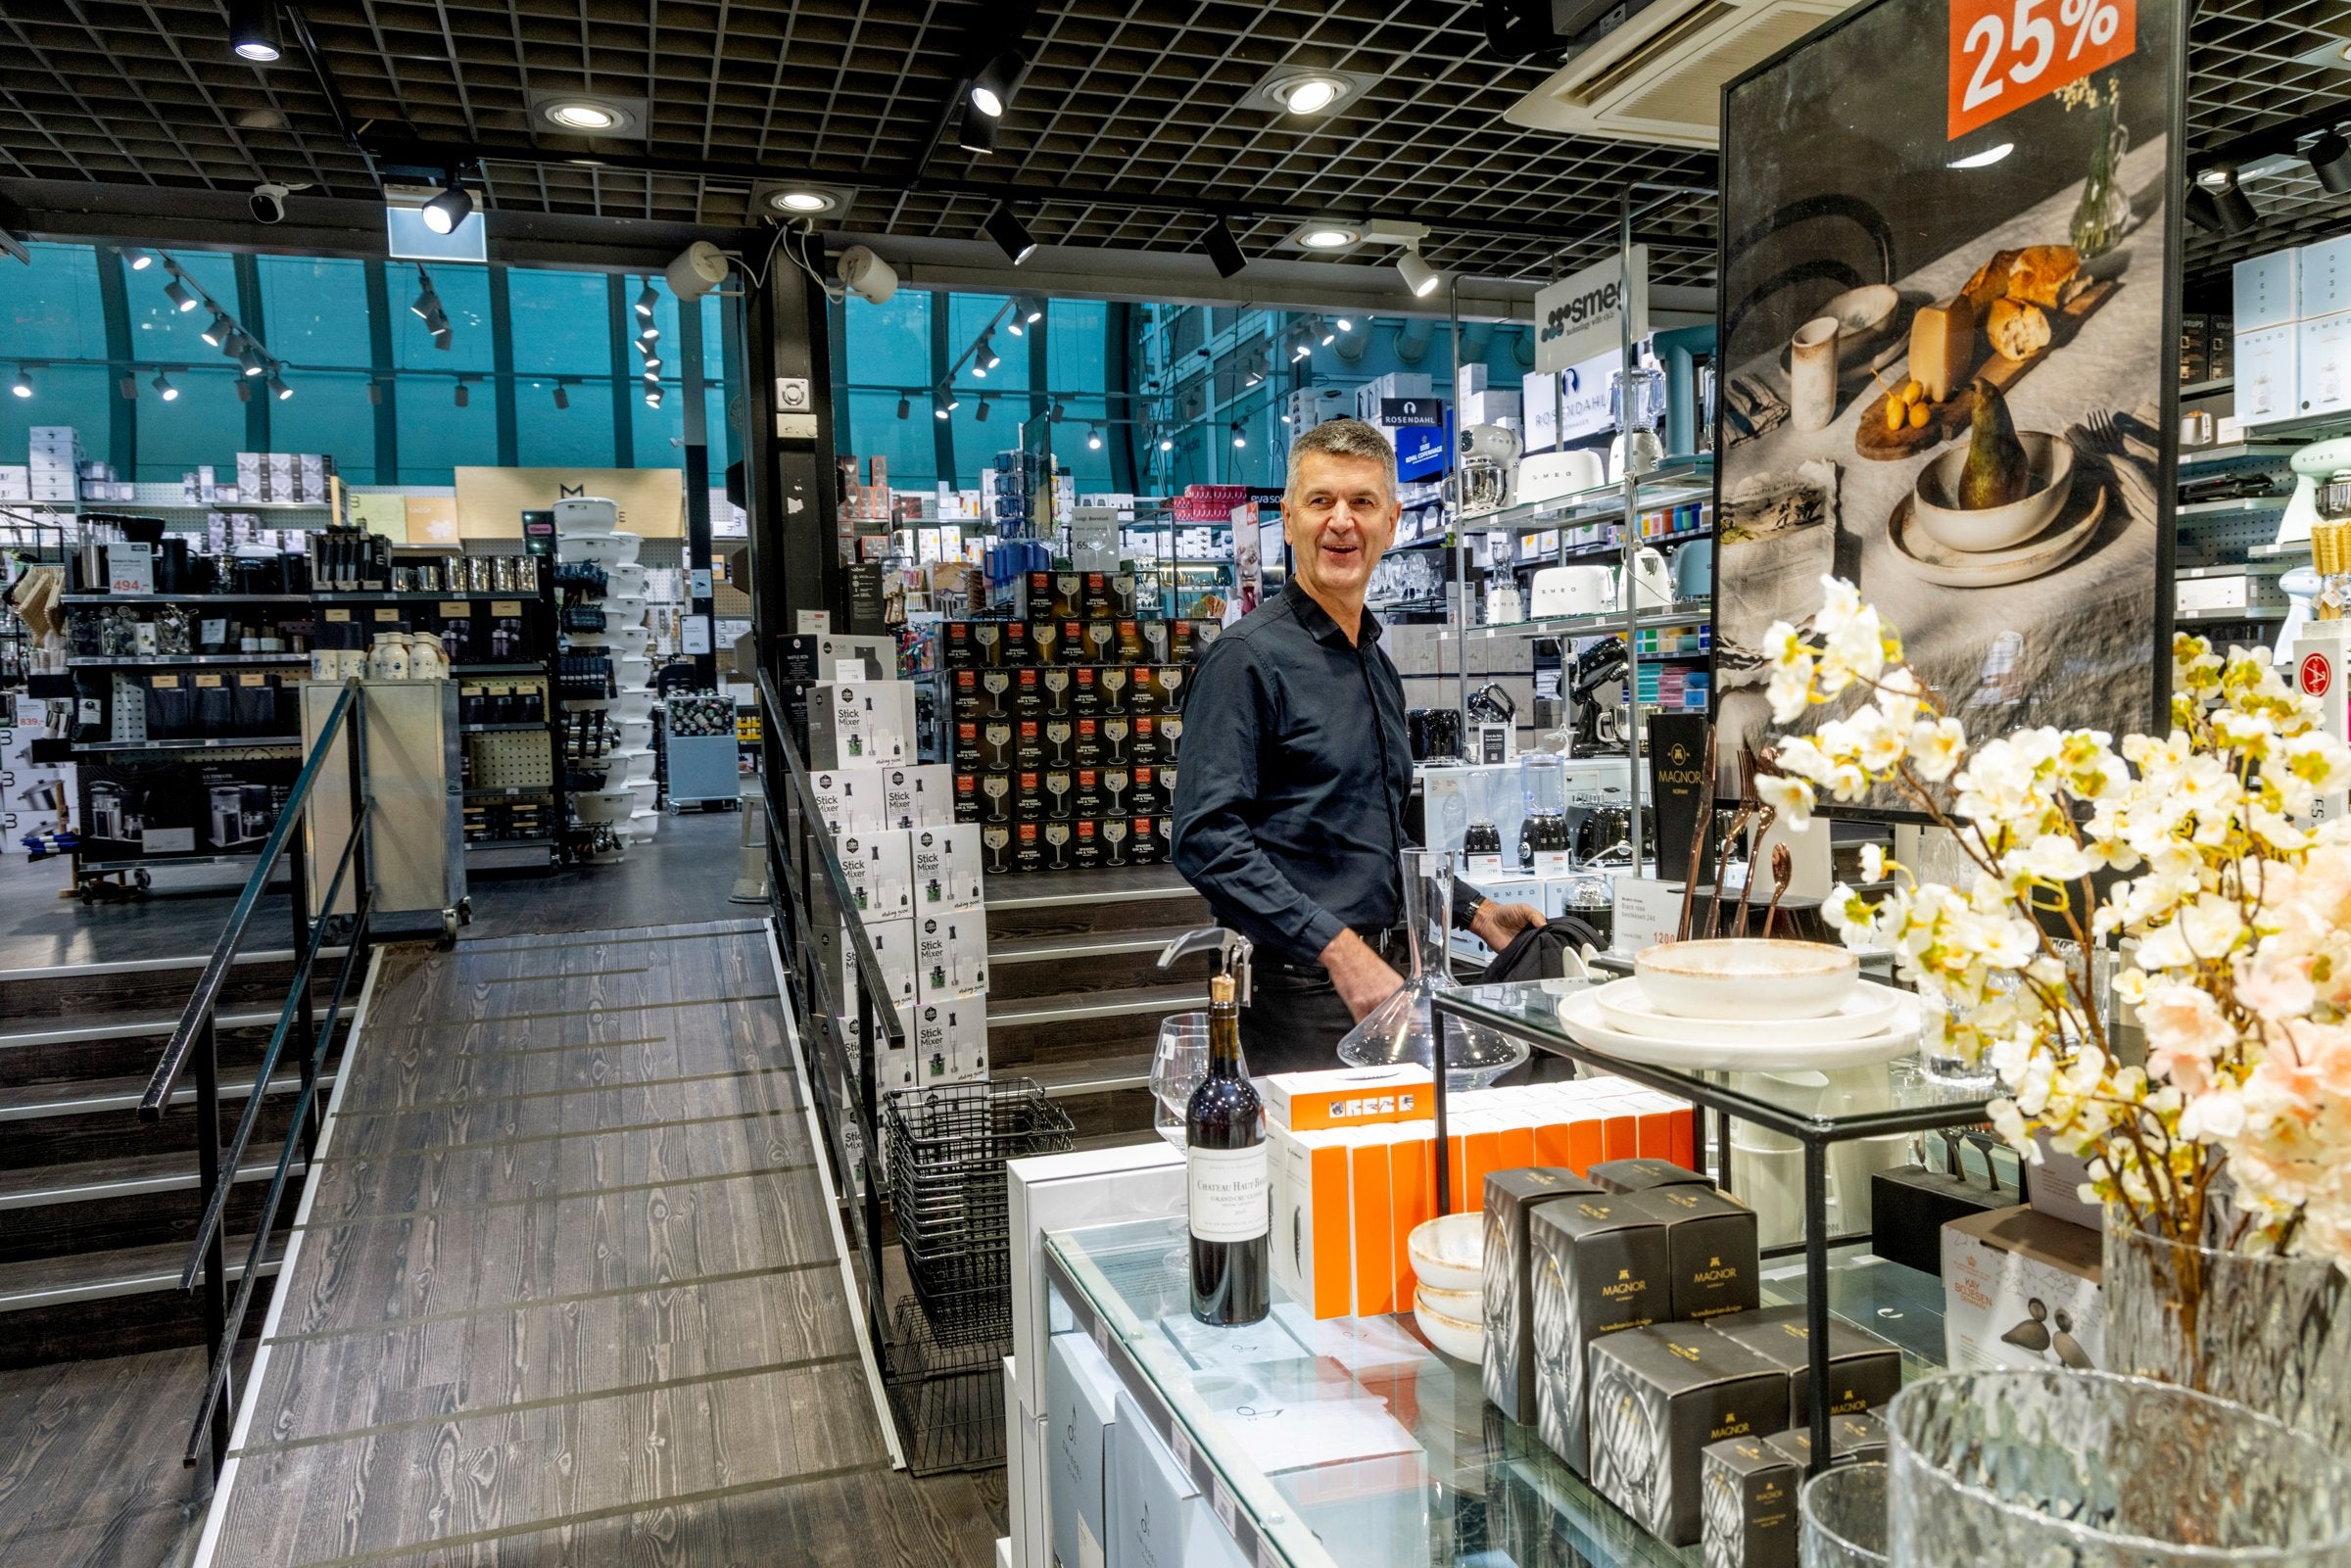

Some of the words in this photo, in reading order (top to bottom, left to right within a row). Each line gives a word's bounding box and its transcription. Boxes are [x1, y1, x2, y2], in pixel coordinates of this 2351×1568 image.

[1962, 0, 2119, 112] 25%
[114, 580, 149, 593] 494,-
[839, 709, 859, 718] Stick
[1658, 770, 1703, 784] MAGNOR
[888, 791, 909, 801] Stick
[917, 853, 938, 864] Stick
[842, 860, 865, 871] Stick
[1493, 889, 1535, 898] SMEG
[921, 941, 942, 951] Stick
[921, 950, 943, 959] Mixer
[921, 1028, 942, 1039] Stick
[1197, 1178, 1231, 1193] CHATEAU
[1233, 1181, 1254, 1191] HAUT
[1694, 1267, 1737, 1283] MAGNOR
[1602, 1280, 1647, 1297] MAGNOR
[1965, 1277, 1980, 1291] KAY
[1954, 1282, 1992, 1307] BOJESEN
[1831, 1400, 1867, 1415] MAGNOR
[1711, 1422, 1750, 1439] MAGNOR
